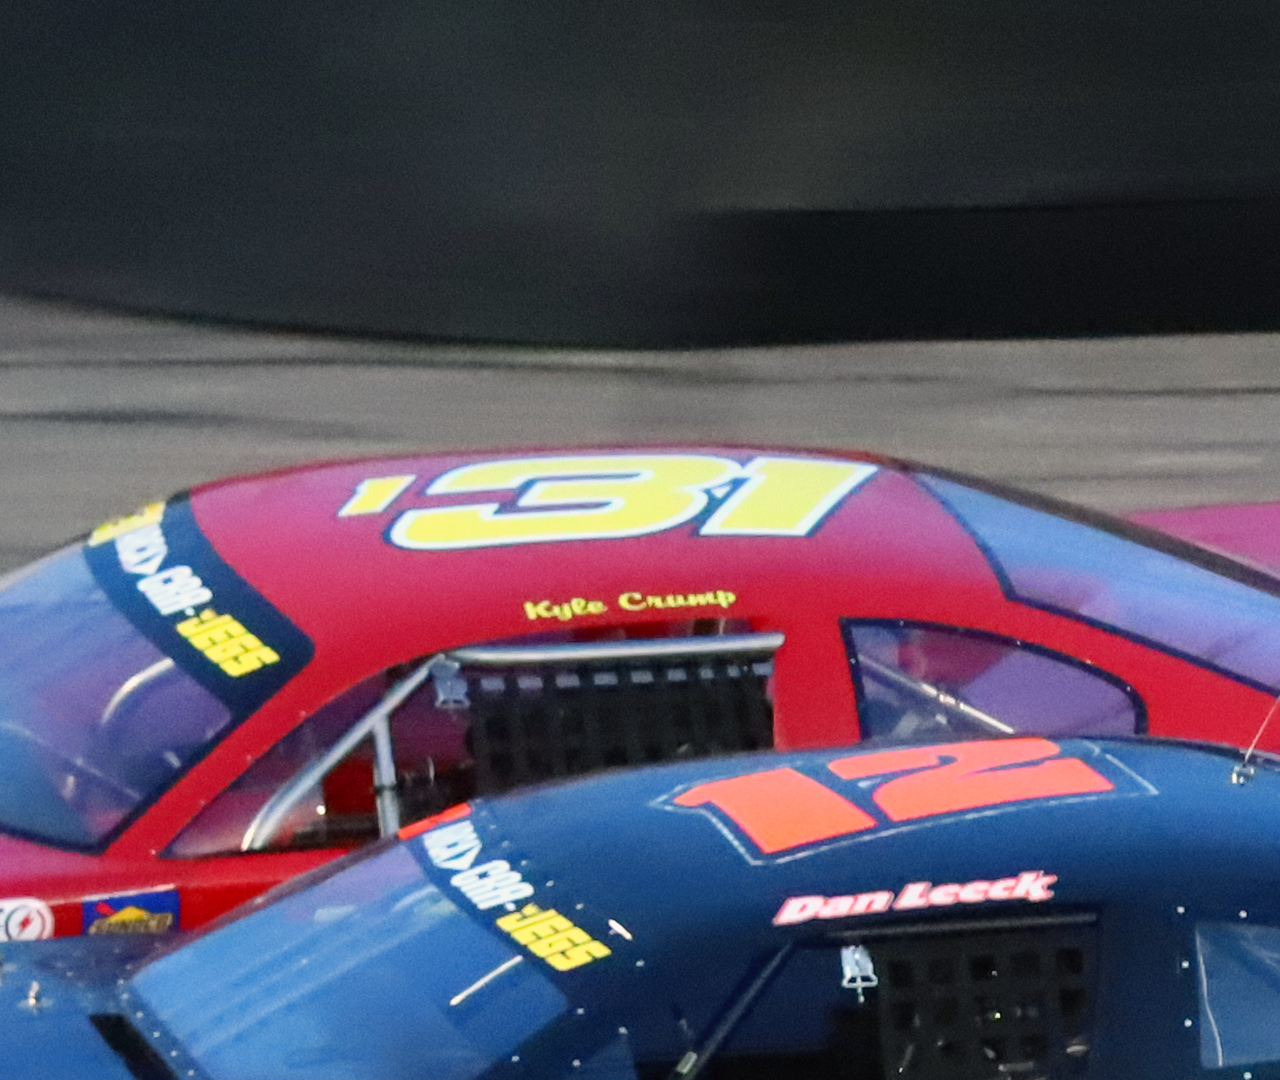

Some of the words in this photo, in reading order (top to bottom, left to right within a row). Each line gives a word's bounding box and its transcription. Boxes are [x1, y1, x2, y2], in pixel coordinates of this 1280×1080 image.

[383, 454, 878, 551] 31
[523, 597, 608, 621] Kyle
[618, 589, 737, 612] Crump
[673, 737, 1116, 855] 12
[495, 902, 613, 972] JEGS
[772, 894, 895, 927] Dan
